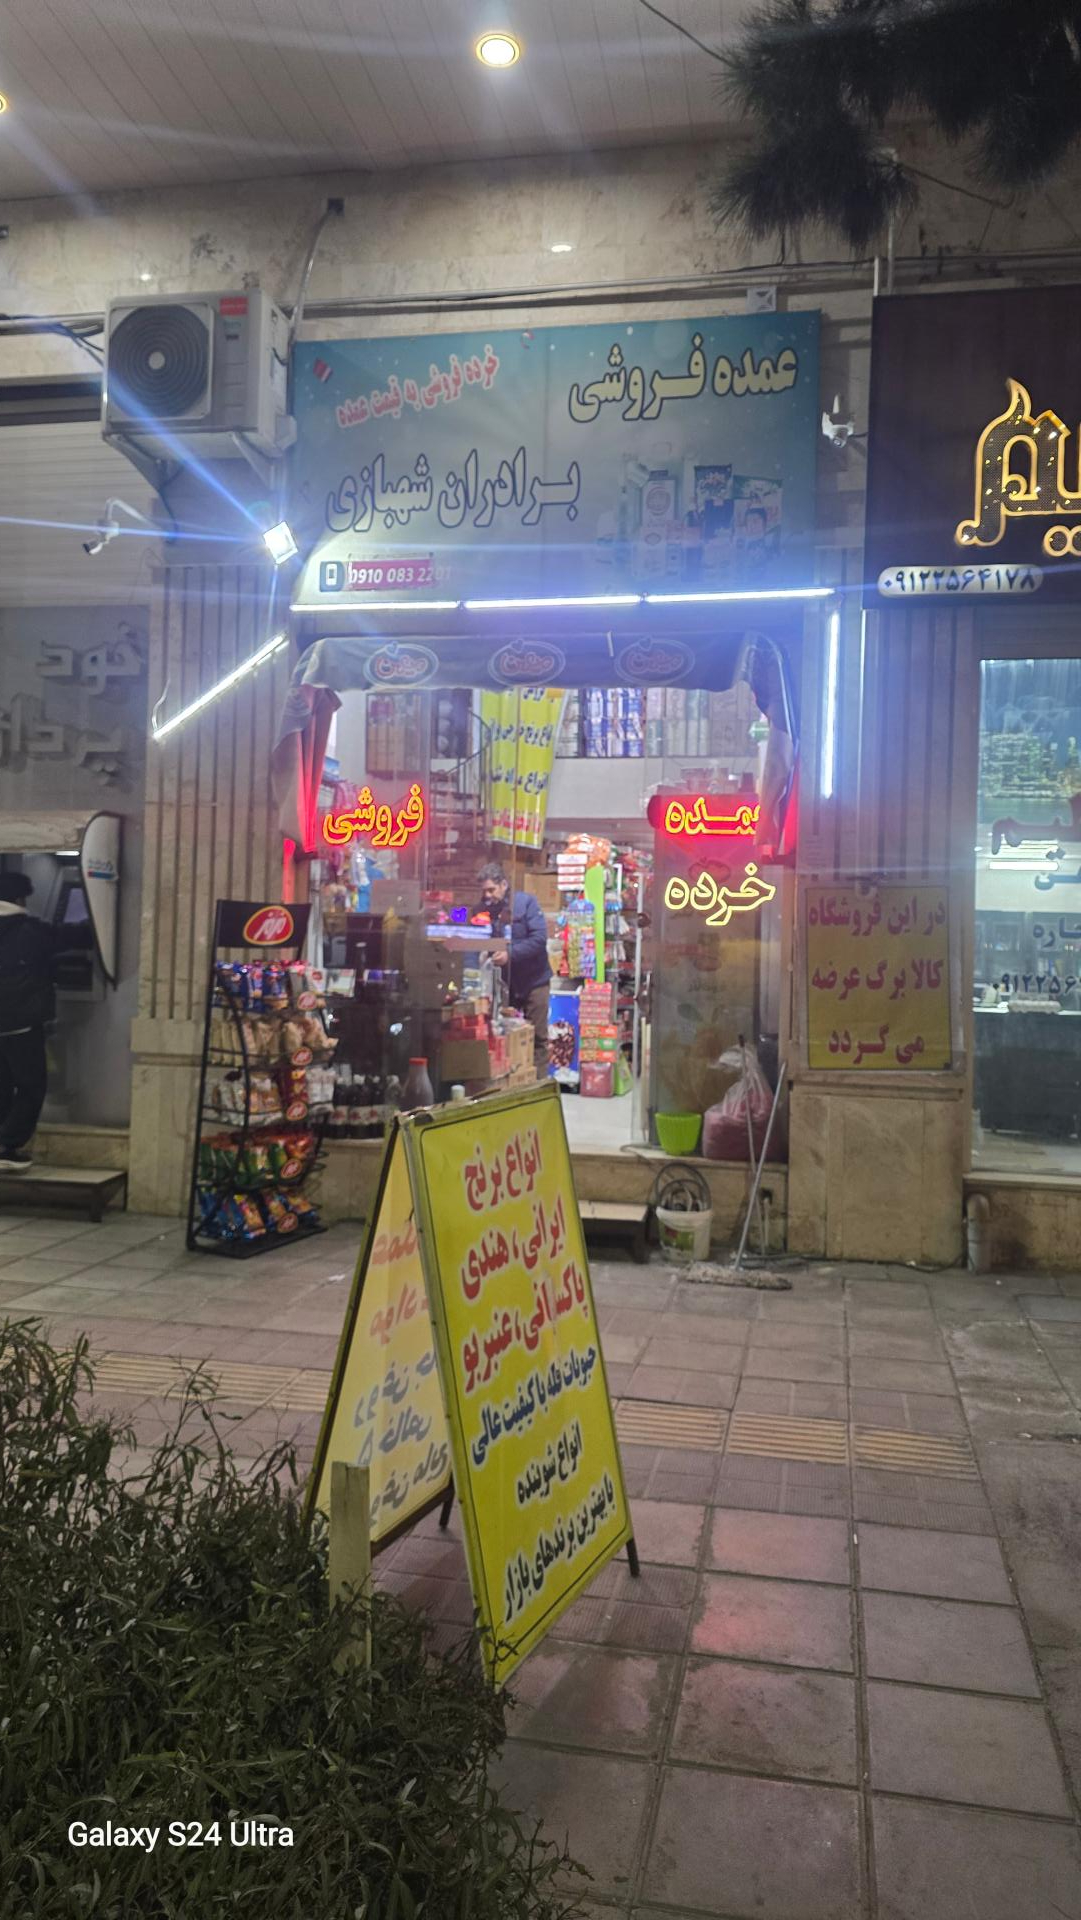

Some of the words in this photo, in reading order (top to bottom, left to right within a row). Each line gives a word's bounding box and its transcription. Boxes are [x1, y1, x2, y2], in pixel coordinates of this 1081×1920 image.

[421, 353, 463, 408] فروشی
[464, 343, 499, 390] خرده
[568, 332, 707, 424] فروشی
[711, 347, 799, 397] عمده
[336, 396, 370, 428] عمده
[371, 374, 402, 418] قیمت
[325, 453, 434, 533] شهبازی
[438, 446, 581, 529] برادران
[349, 567, 384, 584] 0910
[386, 567, 414, 583] 083
[322, 783, 424, 847] فروشی
[664, 862, 777, 926] خرده
[808, 893, 882, 937] فروشگاه
[887, 895, 918, 936] این
[923, 901, 947, 936] در
[811, 959, 861, 1001] عرضه
[866, 959, 907, 1001] برگ
[912, 958, 945, 990] کالا
[828, 1023, 890, 1065] گردد
[896, 1035, 925, 1065] می
[464, 1145, 505, 1212] برنج
[506, 1128, 542, 1198] انواع
[461, 1229, 509, 1300] هندی
[547, 1359, 563, 1397] فله
[562, 1346, 597, 1387] حبوبات
[502, 1375, 536, 1433] کیفیت
[535, 1372, 549, 1414] با
[472, 1405, 502, 1466] عالی
[557, 1420, 583, 1481] انواع
[517, 1444, 557, 1505] شوینده
[604, 1472, 616, 1510] با
[576, 1487, 609, 1547] بهترین
[505, 1552, 533, 1623] بازار
